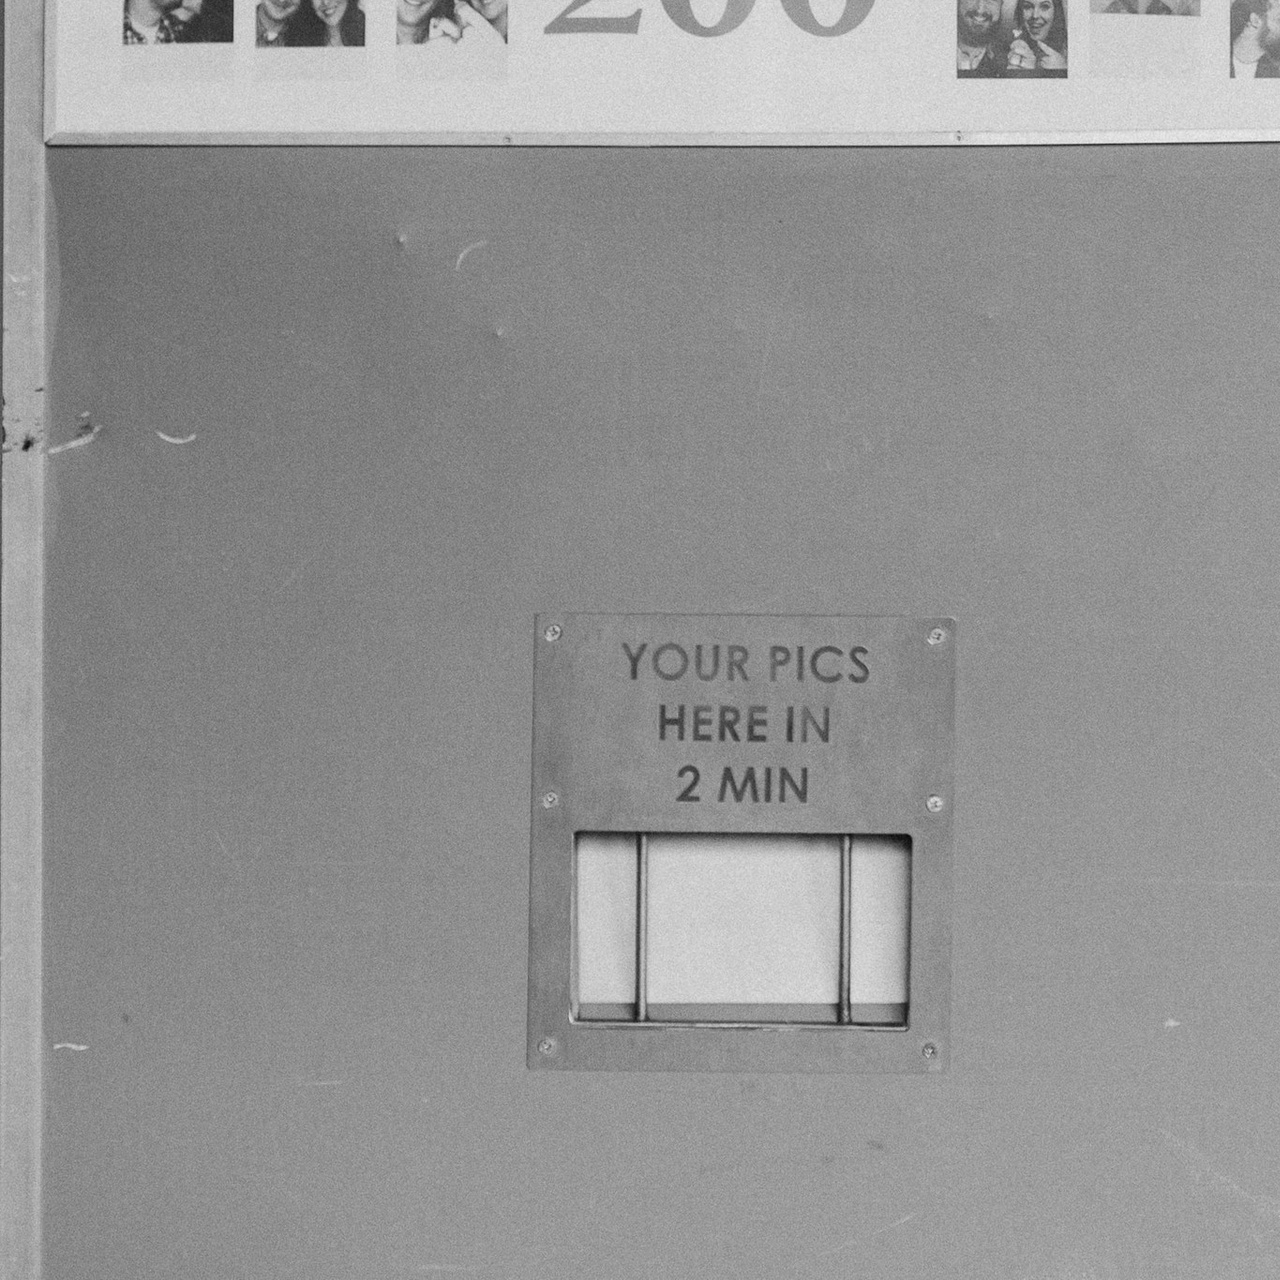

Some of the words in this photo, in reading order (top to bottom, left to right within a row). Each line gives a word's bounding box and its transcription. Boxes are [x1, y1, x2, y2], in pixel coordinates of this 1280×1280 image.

[621, 641, 750, 682] YOUR
[769, 644, 870, 683] PICS
[658, 704, 768, 742] HERE
[786, 706, 830, 743] IN
[676, 764, 701, 803] 2
[718, 766, 809, 803] MIN
